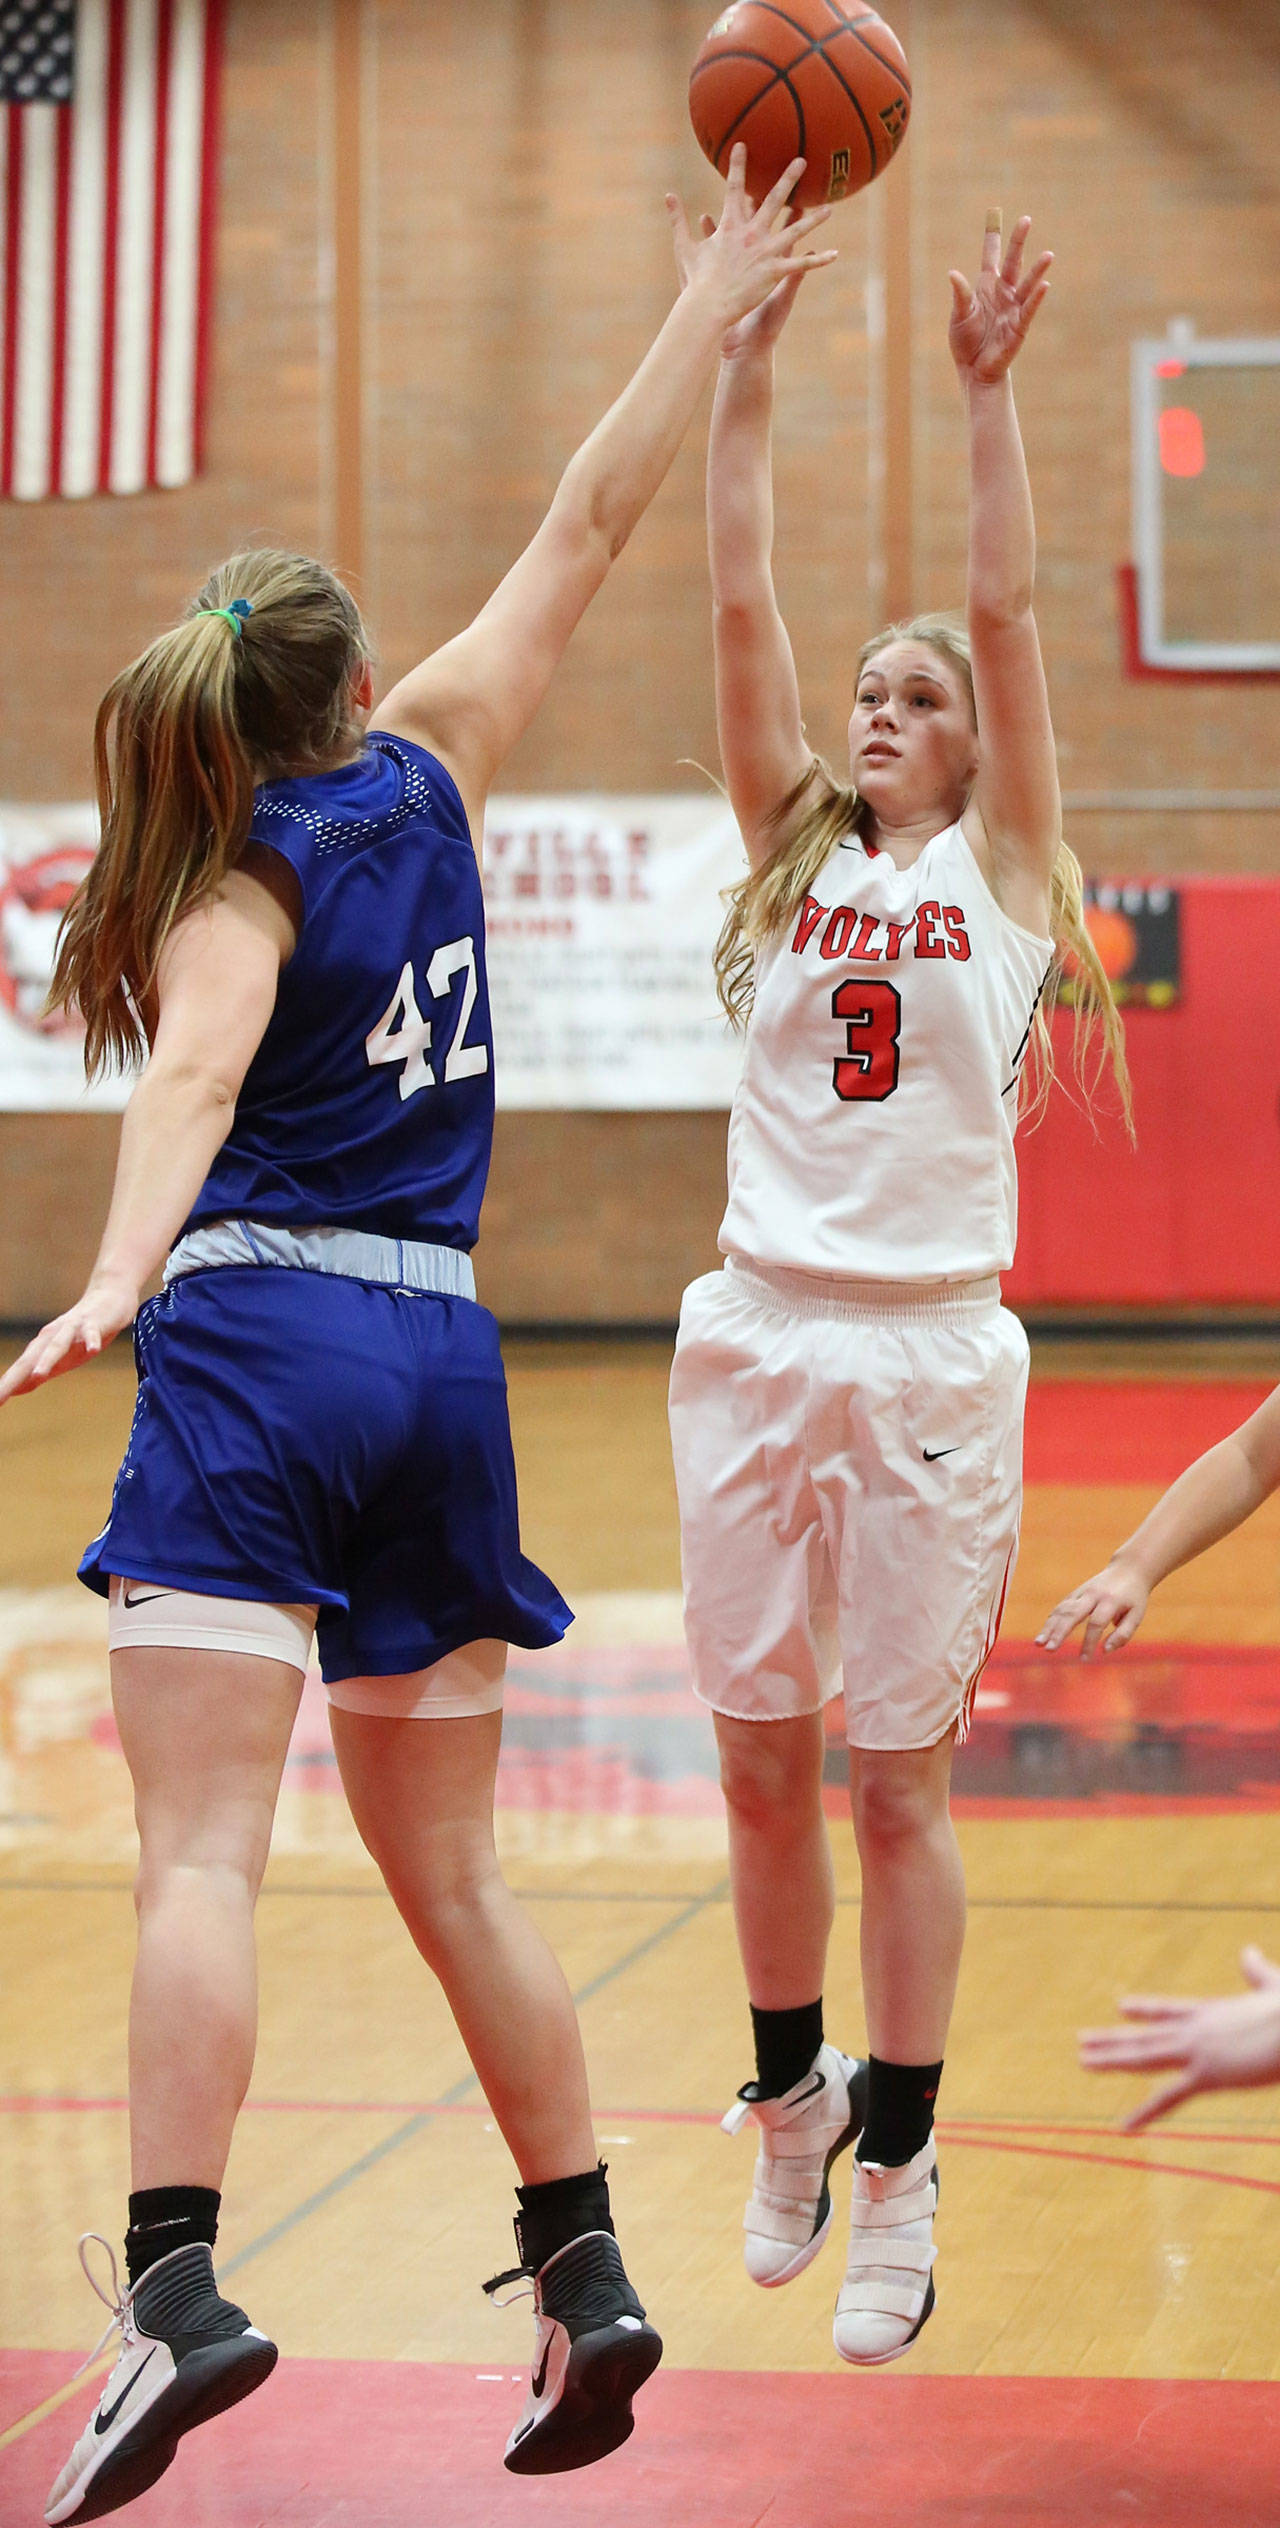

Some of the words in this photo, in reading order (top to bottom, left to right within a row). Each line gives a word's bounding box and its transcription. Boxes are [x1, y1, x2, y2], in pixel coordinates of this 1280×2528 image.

[791, 894, 972, 962] WOLVES
[365, 935, 489, 1101] 42
[831, 978, 901, 1102] 3
